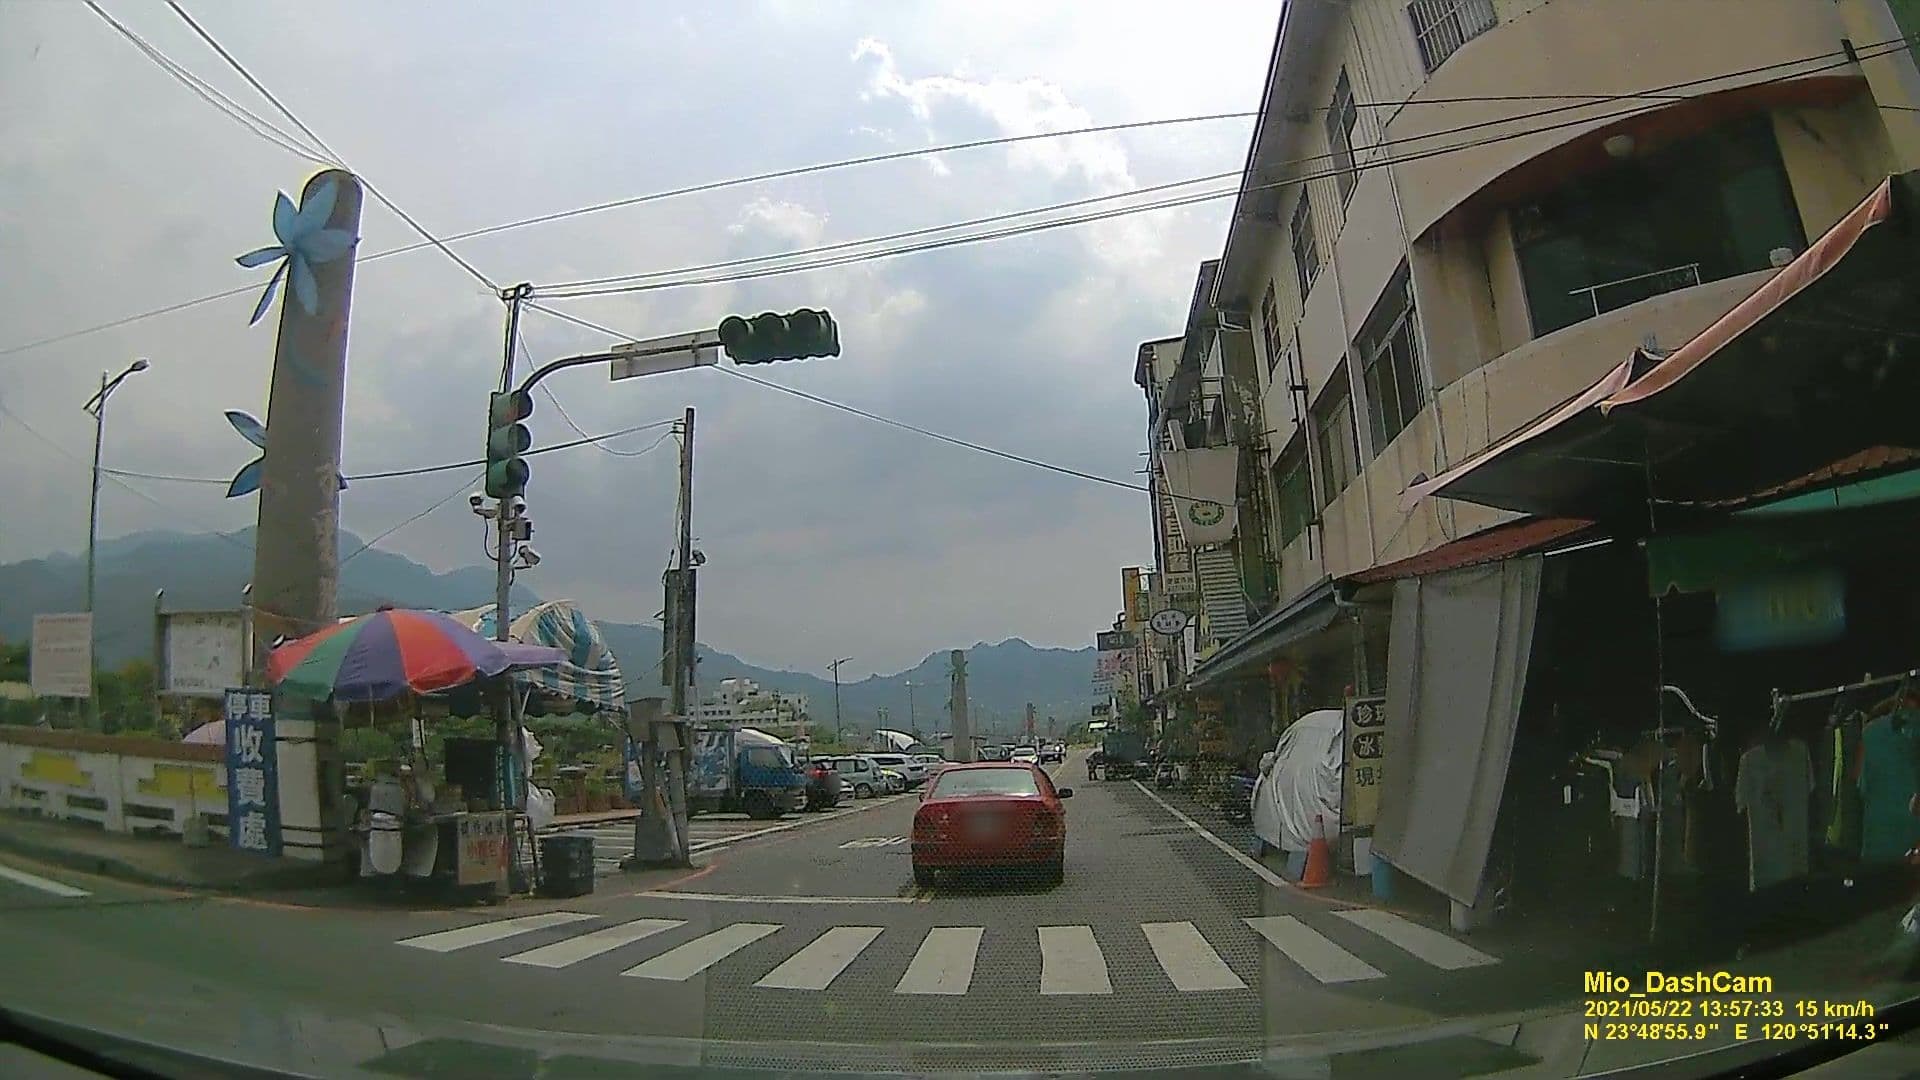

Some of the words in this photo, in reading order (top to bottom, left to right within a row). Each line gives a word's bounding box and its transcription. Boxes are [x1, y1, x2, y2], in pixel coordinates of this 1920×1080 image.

[227, 692, 272, 720] 停車
[234, 723, 268, 849] 收費處
